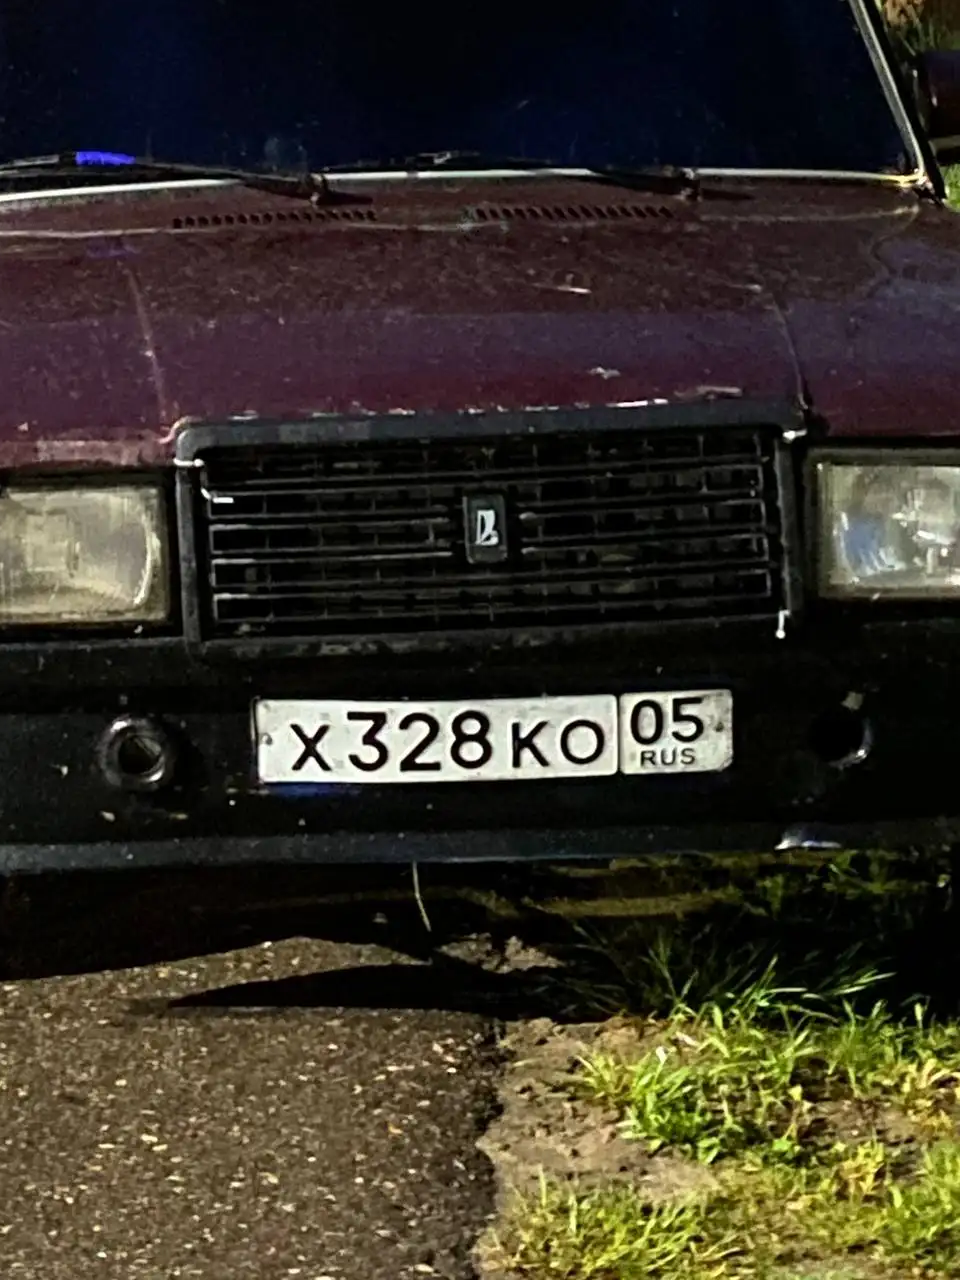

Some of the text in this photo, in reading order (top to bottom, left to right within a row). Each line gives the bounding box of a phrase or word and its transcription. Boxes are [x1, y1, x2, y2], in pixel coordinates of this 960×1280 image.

[289, 696, 705, 772] Х328КО 05
[640, 747, 696, 767] RUS
